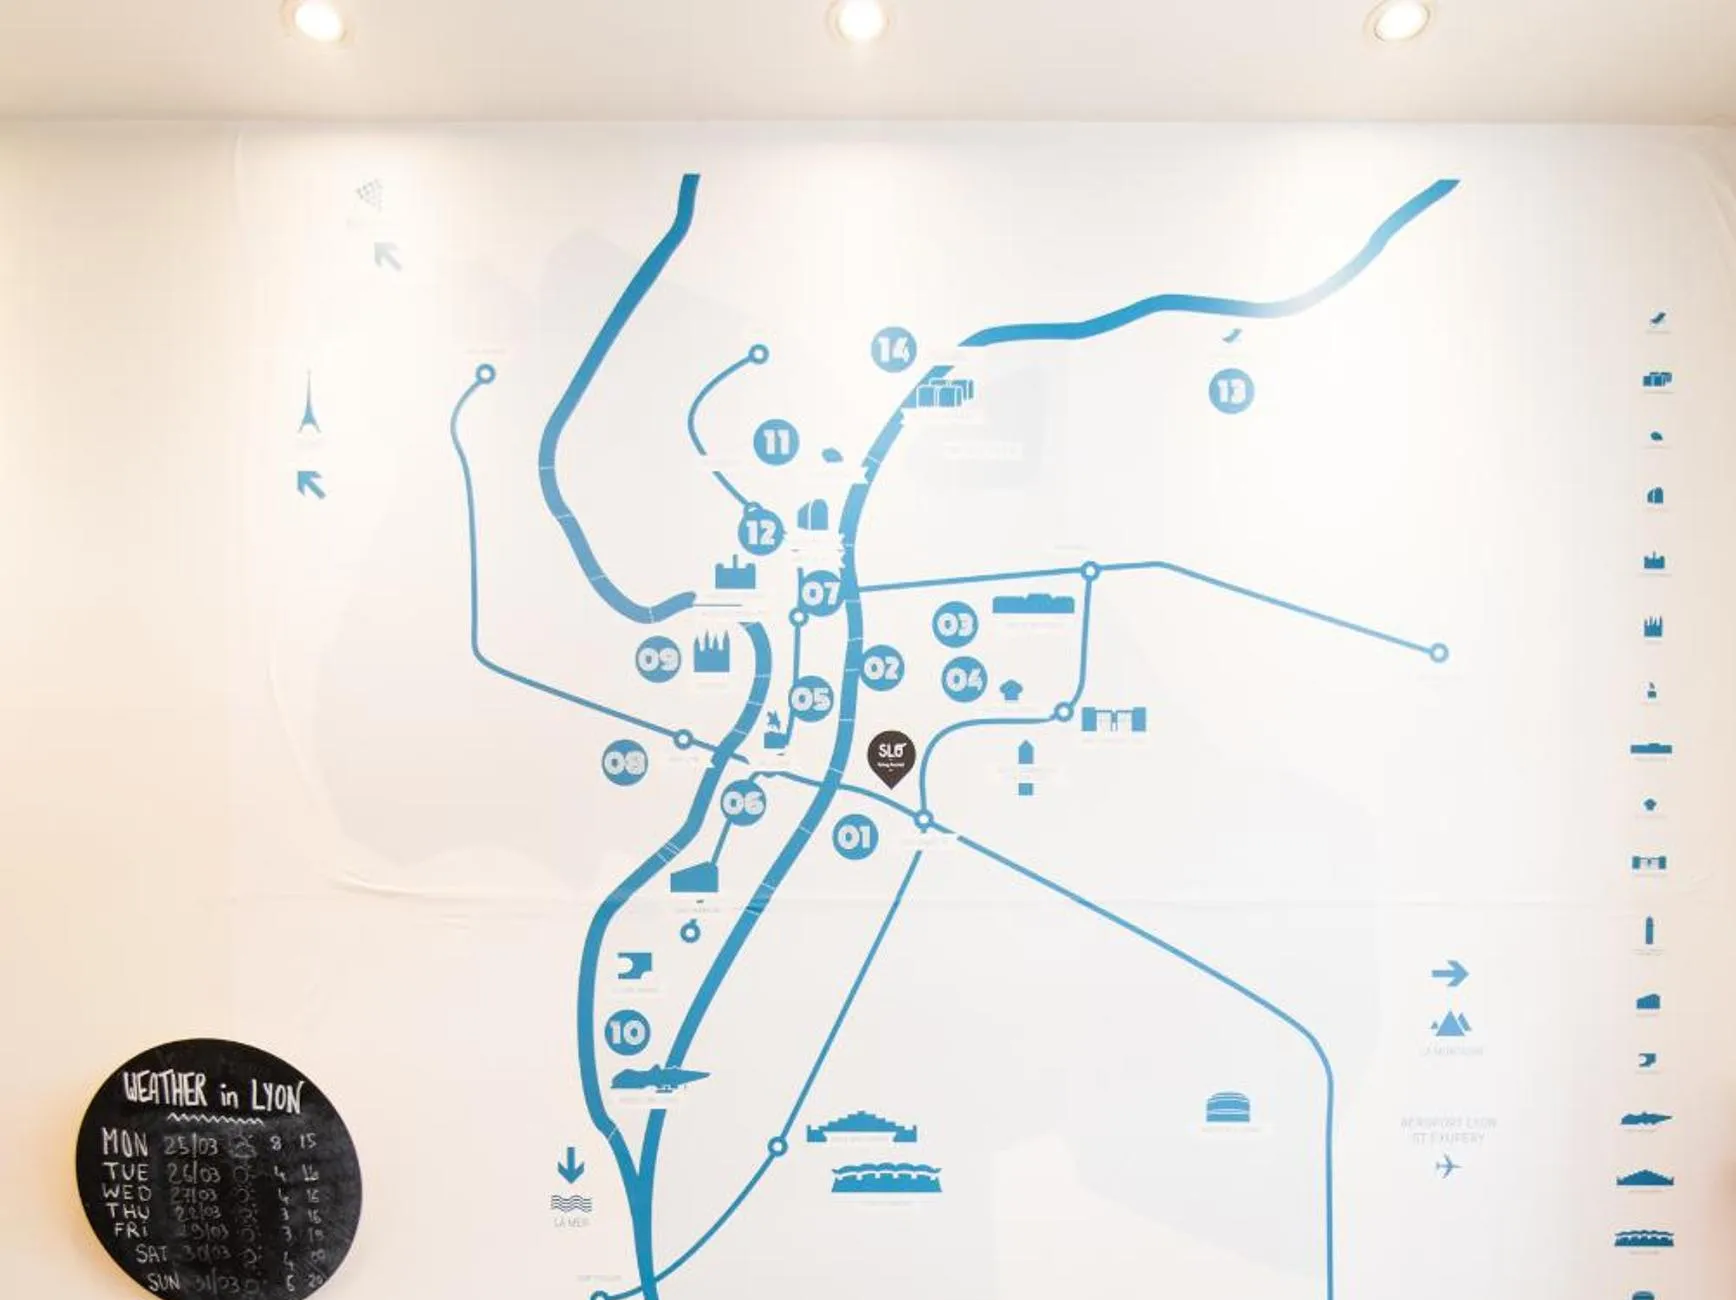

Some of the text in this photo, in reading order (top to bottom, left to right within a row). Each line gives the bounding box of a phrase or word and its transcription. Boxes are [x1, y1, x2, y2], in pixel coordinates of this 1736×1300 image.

[874, 335, 910, 363] 14
[763, 428, 791, 455] 11
[745, 519, 777, 546] 12
[802, 580, 841, 606] 07
[937, 612, 974, 637] 03
[638, 647, 678, 673] 09
[864, 656, 899, 681] 02
[945, 667, 984, 693] 04
[792, 687, 831, 712] 05
[605, 751, 645, 775] 08
[723, 791, 763, 815] 06
[838, 825, 872, 849] 01
[609, 1021, 645, 1046] 10
[124, 1069, 305, 1114] WEATHER in LYON
[101, 1126, 149, 1157] MON
[163, 1132, 220, 1158] 25/03
[300, 1132, 317, 1149] 15
[103, 1161, 149, 1181] TUE
[101, 1182, 152, 1202] WED
[106, 1202, 150, 1220] THU
[135, 1243, 168, 1263] SAT
[147, 1272, 181, 1292] SUN
